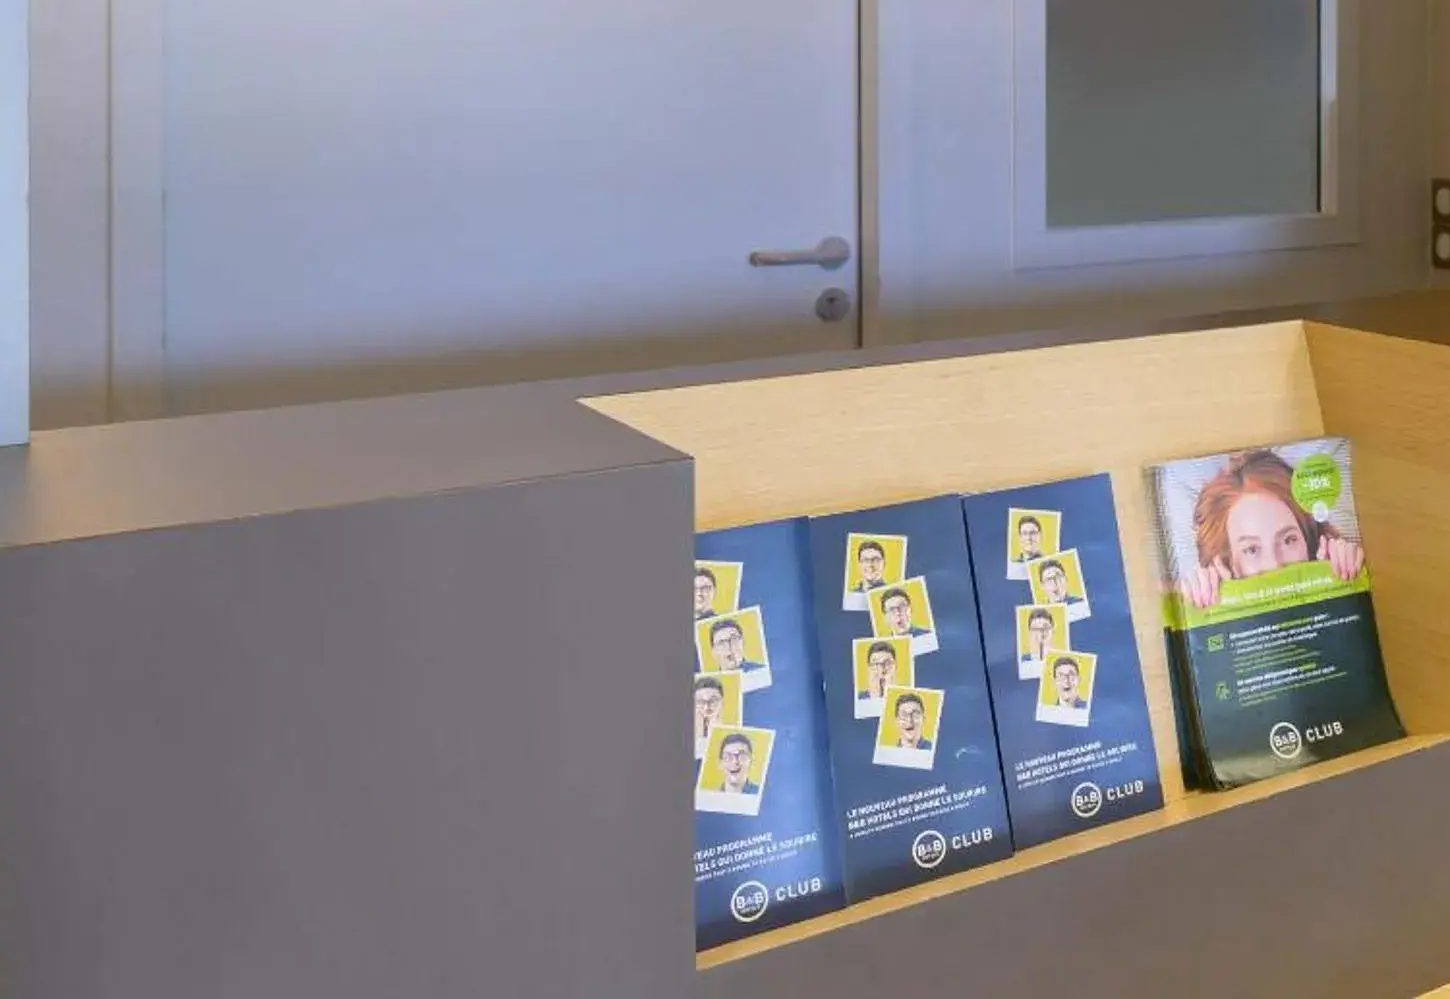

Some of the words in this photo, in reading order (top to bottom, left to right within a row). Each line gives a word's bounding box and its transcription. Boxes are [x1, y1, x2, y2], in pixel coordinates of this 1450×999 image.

[1273, 731, 1297, 747] B&B
[1305, 721, 1343, 742] CLUB
[1076, 791, 1098, 807] B&B
[1106, 780, 1144, 801] CLUB
[917, 840, 942, 857] B&B
[952, 827, 993, 850] CLUB
[735, 891, 765, 910] B&B
[775, 877, 822, 901] CLUB
